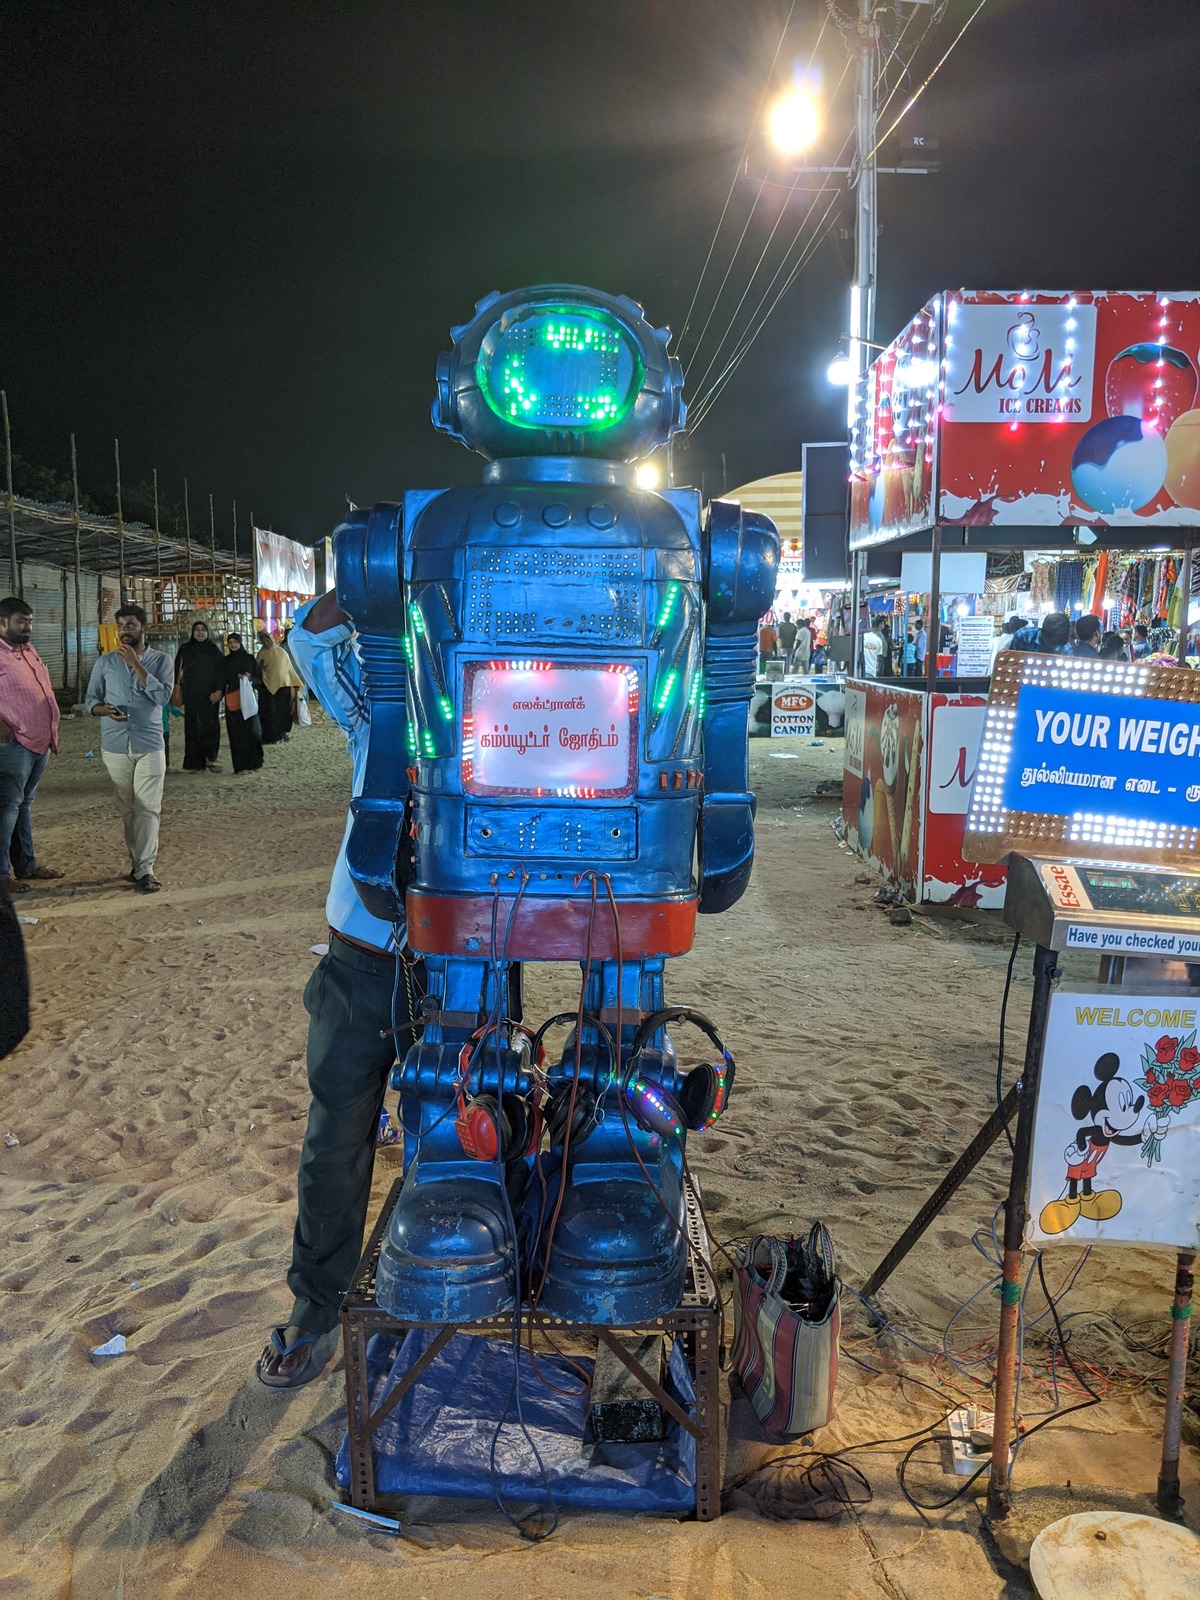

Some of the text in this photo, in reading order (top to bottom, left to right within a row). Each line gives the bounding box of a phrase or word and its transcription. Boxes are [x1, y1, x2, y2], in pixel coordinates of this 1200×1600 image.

[998, 398, 1082, 414] ICE CREAMS
[512, 696, 586, 712] எலக்ட்ரானிக்
[781, 696, 807, 707] MFC
[773, 715, 814, 723] COTTON
[774, 725, 812, 735] CANDY
[480, 723, 619, 755] கம்ப்யூட்டர் ஜோதிடம்
[1035, 709, 1200, 758] YOUR WEIGH
[1020, 761, 1117, 790] துல்லியமான
[1125, 777, 1161, 795] எடை
[1050, 865, 1081, 908] Essae
[1068, 927, 1098, 943] Have
[1100, 934, 1123, 947] you
[1125, 932, 1175, 950] checked
[1075, 1006, 1197, 1028] WELCOME
